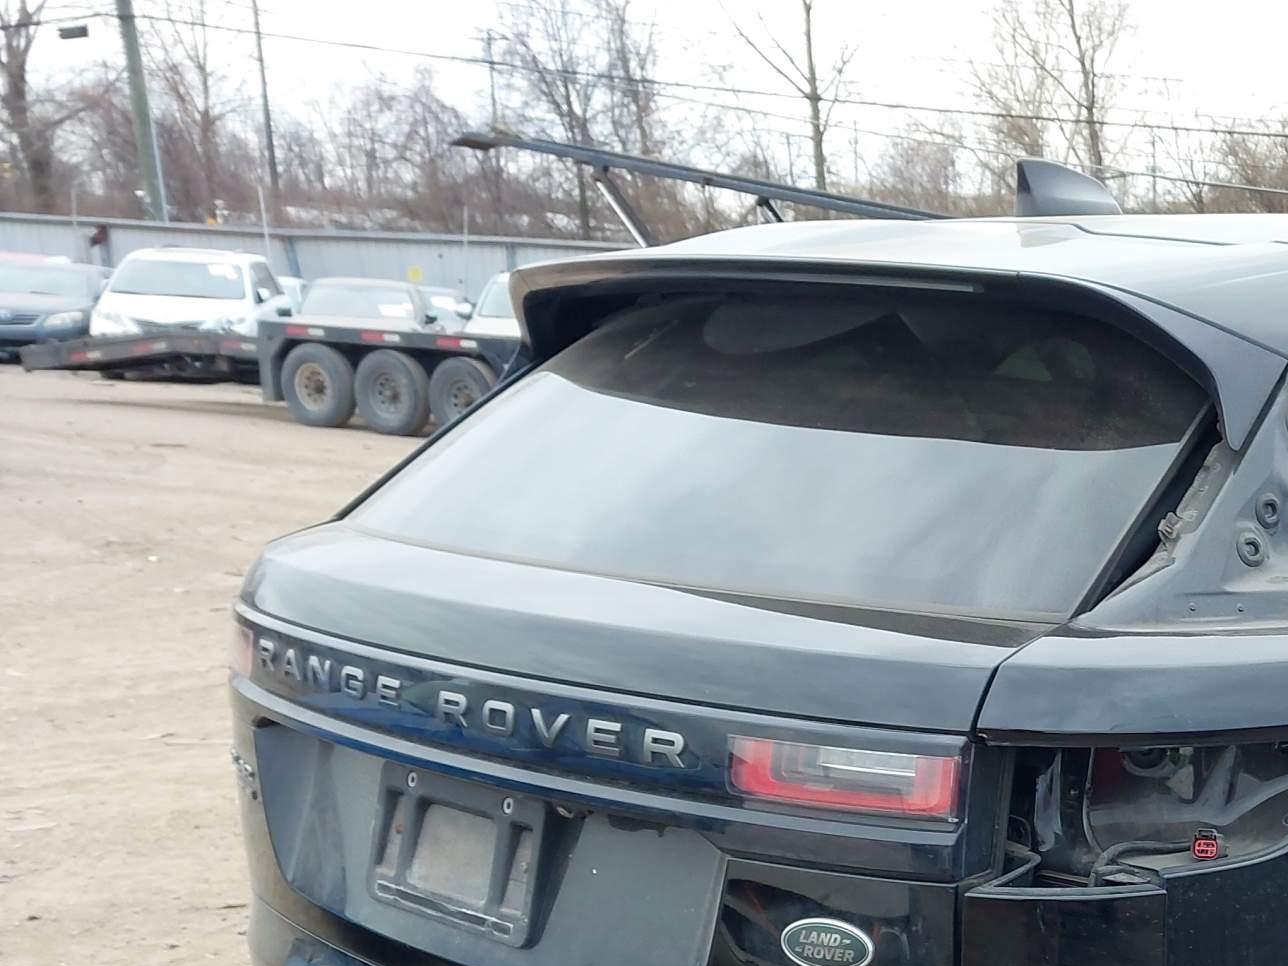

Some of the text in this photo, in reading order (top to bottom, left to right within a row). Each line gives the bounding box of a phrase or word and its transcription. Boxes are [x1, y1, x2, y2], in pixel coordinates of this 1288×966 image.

[258, 637, 688, 769] RANGE ROVER
[799, 929, 841, 947] LAND
[803, 944, 855, 963] ROVER
